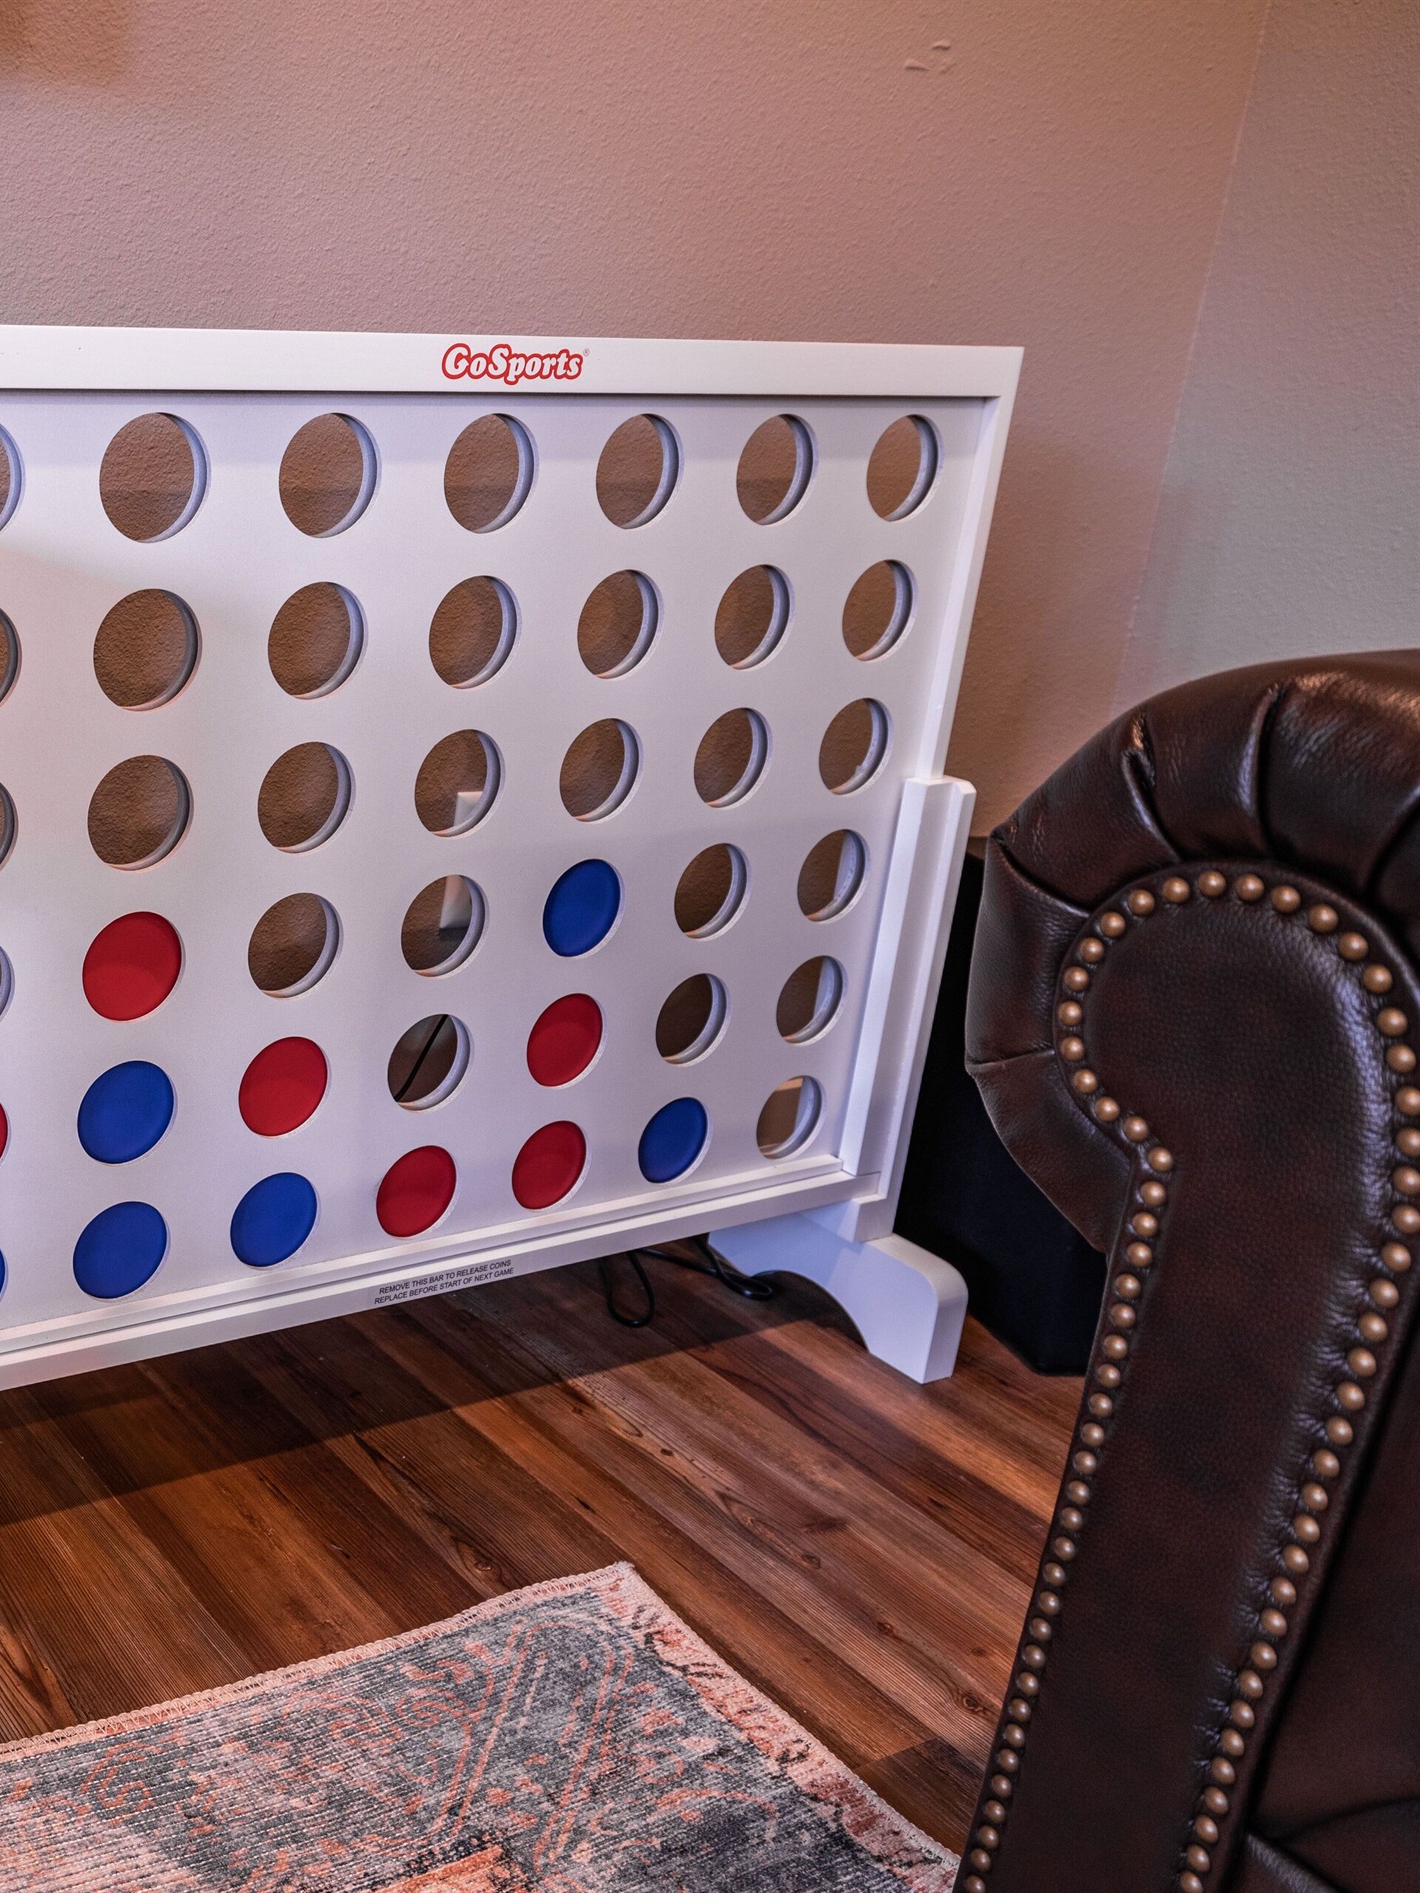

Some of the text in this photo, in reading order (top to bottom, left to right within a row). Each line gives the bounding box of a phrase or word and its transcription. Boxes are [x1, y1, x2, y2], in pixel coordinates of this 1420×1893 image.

[442, 343, 583, 385] GoSports
[374, 1291, 407, 1304] REPLACE
[409, 1285, 438, 1297] BEFORE
[440, 1280, 462, 1290] START
[474, 1272, 493, 1281] NEXT
[494, 1268, 514, 1277] GAME
[379, 1282, 410, 1294] REMOVE
[412, 1278, 428, 1287] THIS
[429, 1275, 444, 1283] BAR
[456, 1265, 488, 1277] RELEASE
[490, 1260, 511, 1270] COINS
